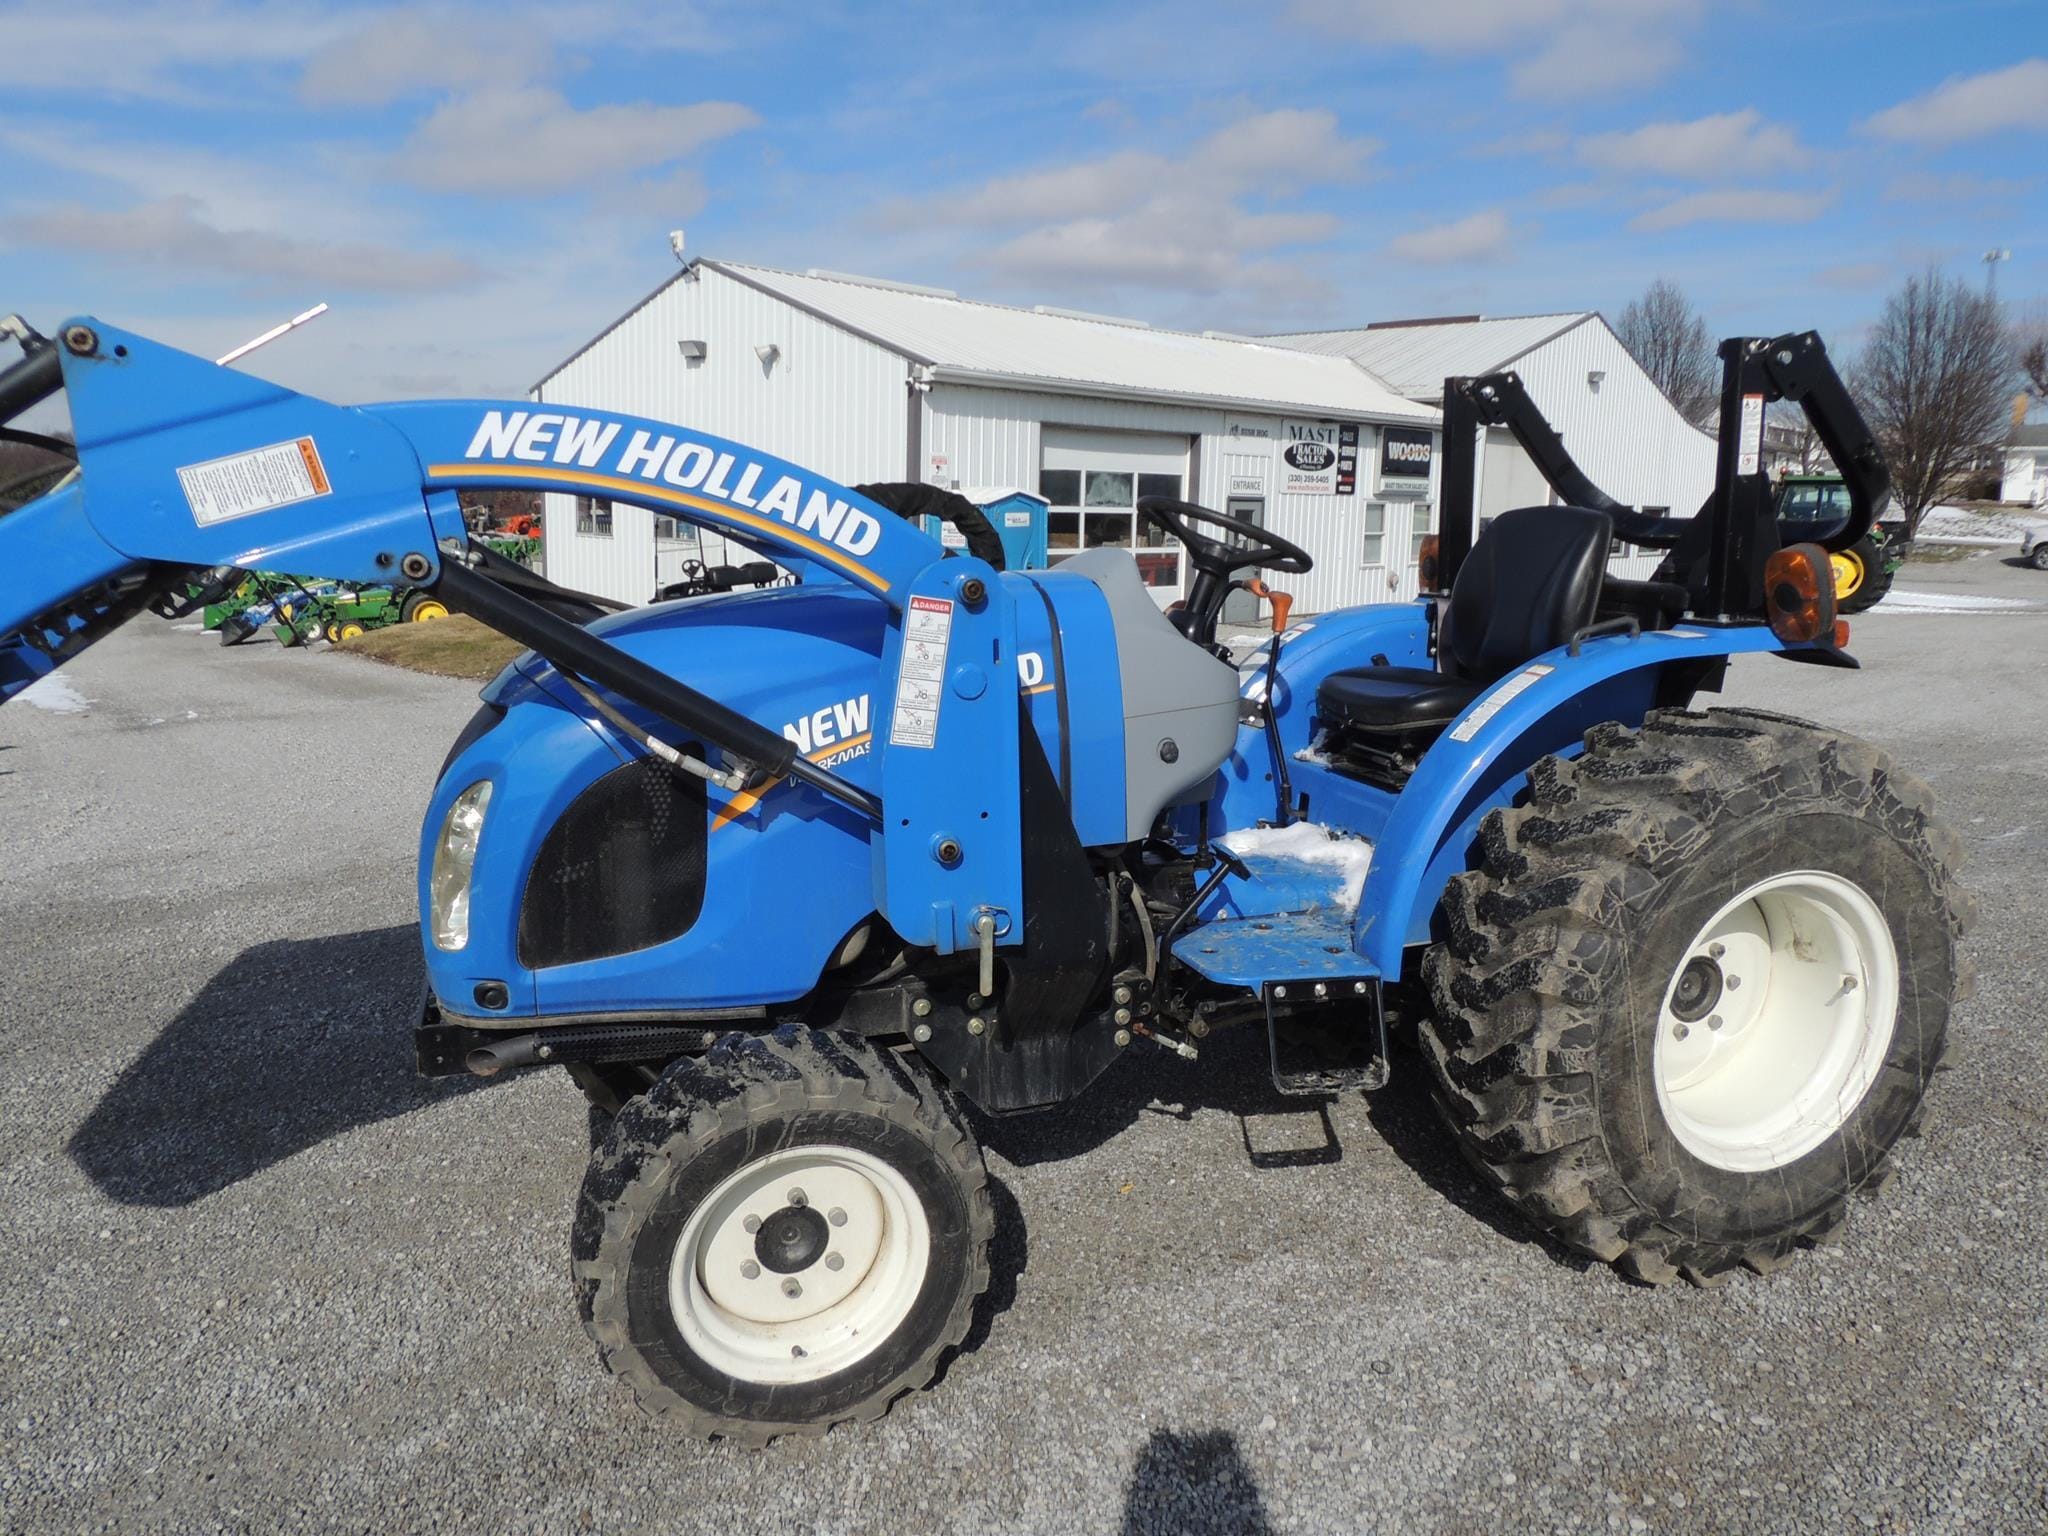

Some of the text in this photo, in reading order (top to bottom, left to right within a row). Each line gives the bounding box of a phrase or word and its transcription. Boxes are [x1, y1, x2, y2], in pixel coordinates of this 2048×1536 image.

[1289, 425, 1335, 444] MAST
[1293, 443, 1327, 457] TRACTOR
[1388, 441, 1431, 462] WOODS
[1296, 453, 1325, 465] SALES
[465, 411, 882, 557] NEW HOLLAND
[1233, 480, 1261, 491] ENTRANCE
[919, 601, 950, 612] DANGER
[784, 694, 869, 754] NEW
